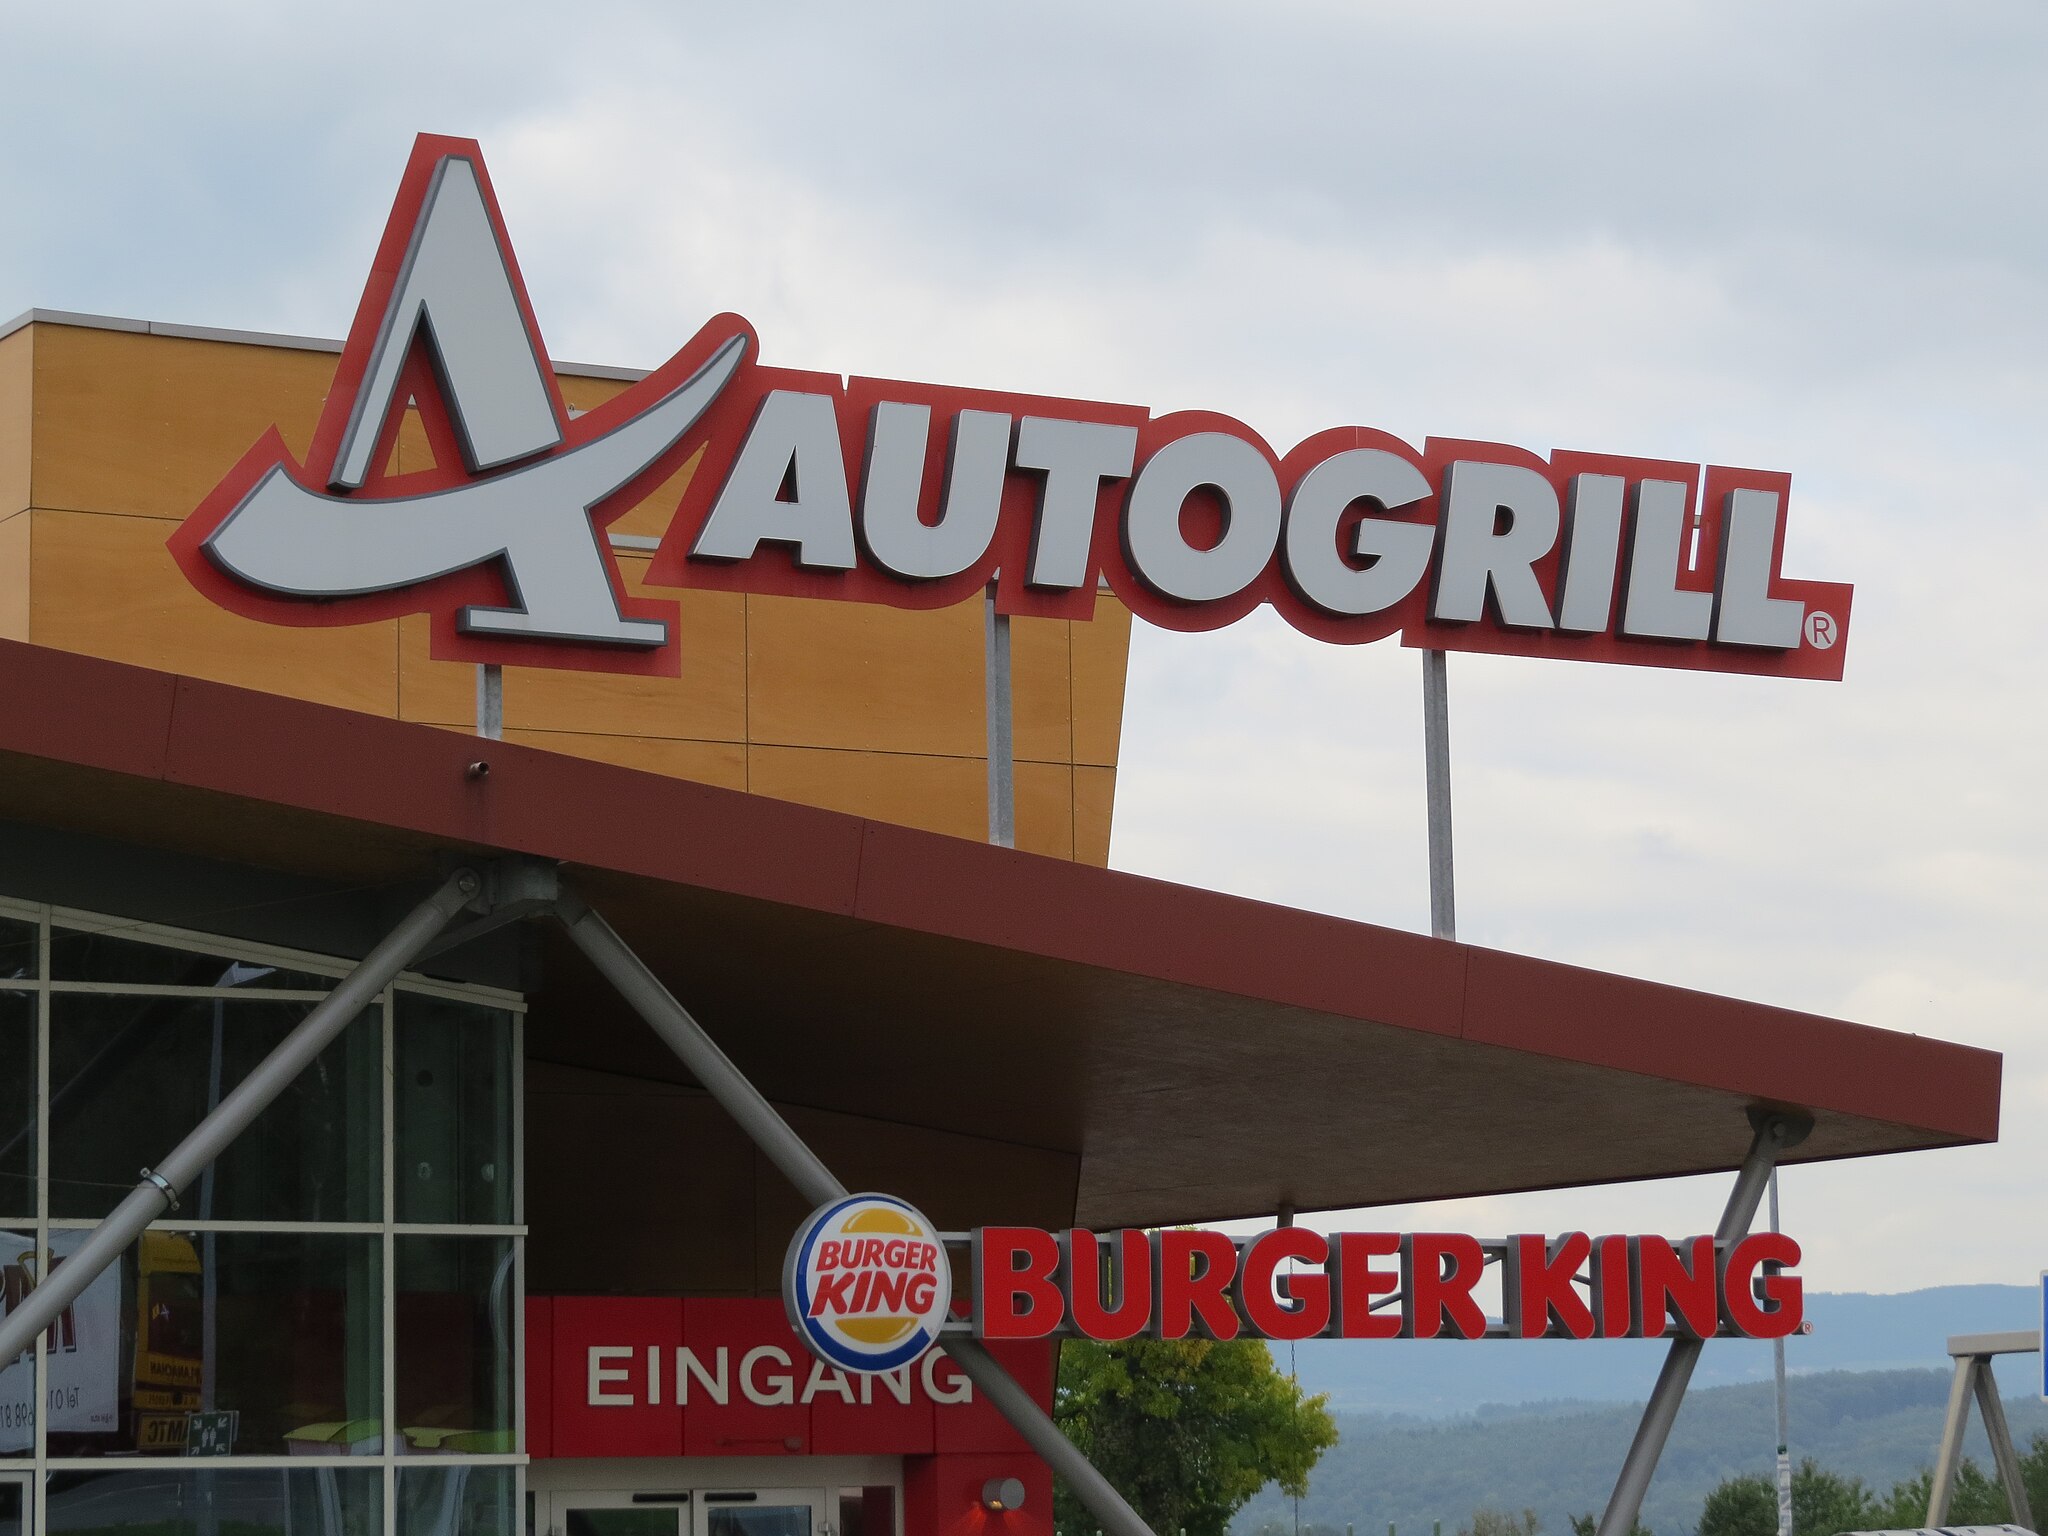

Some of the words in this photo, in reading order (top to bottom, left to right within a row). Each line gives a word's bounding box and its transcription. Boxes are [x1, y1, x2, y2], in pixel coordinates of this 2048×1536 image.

[689, 389, 1803, 649] AUTOGRILL
[815, 1238, 938, 1273] BURGER
[982, 1226, 1487, 1341] BURGER
[1520, 1231, 1804, 1340] KING
[808, 1270, 938, 1317] KING
[587, 1345, 973, 1406] EINGANG
